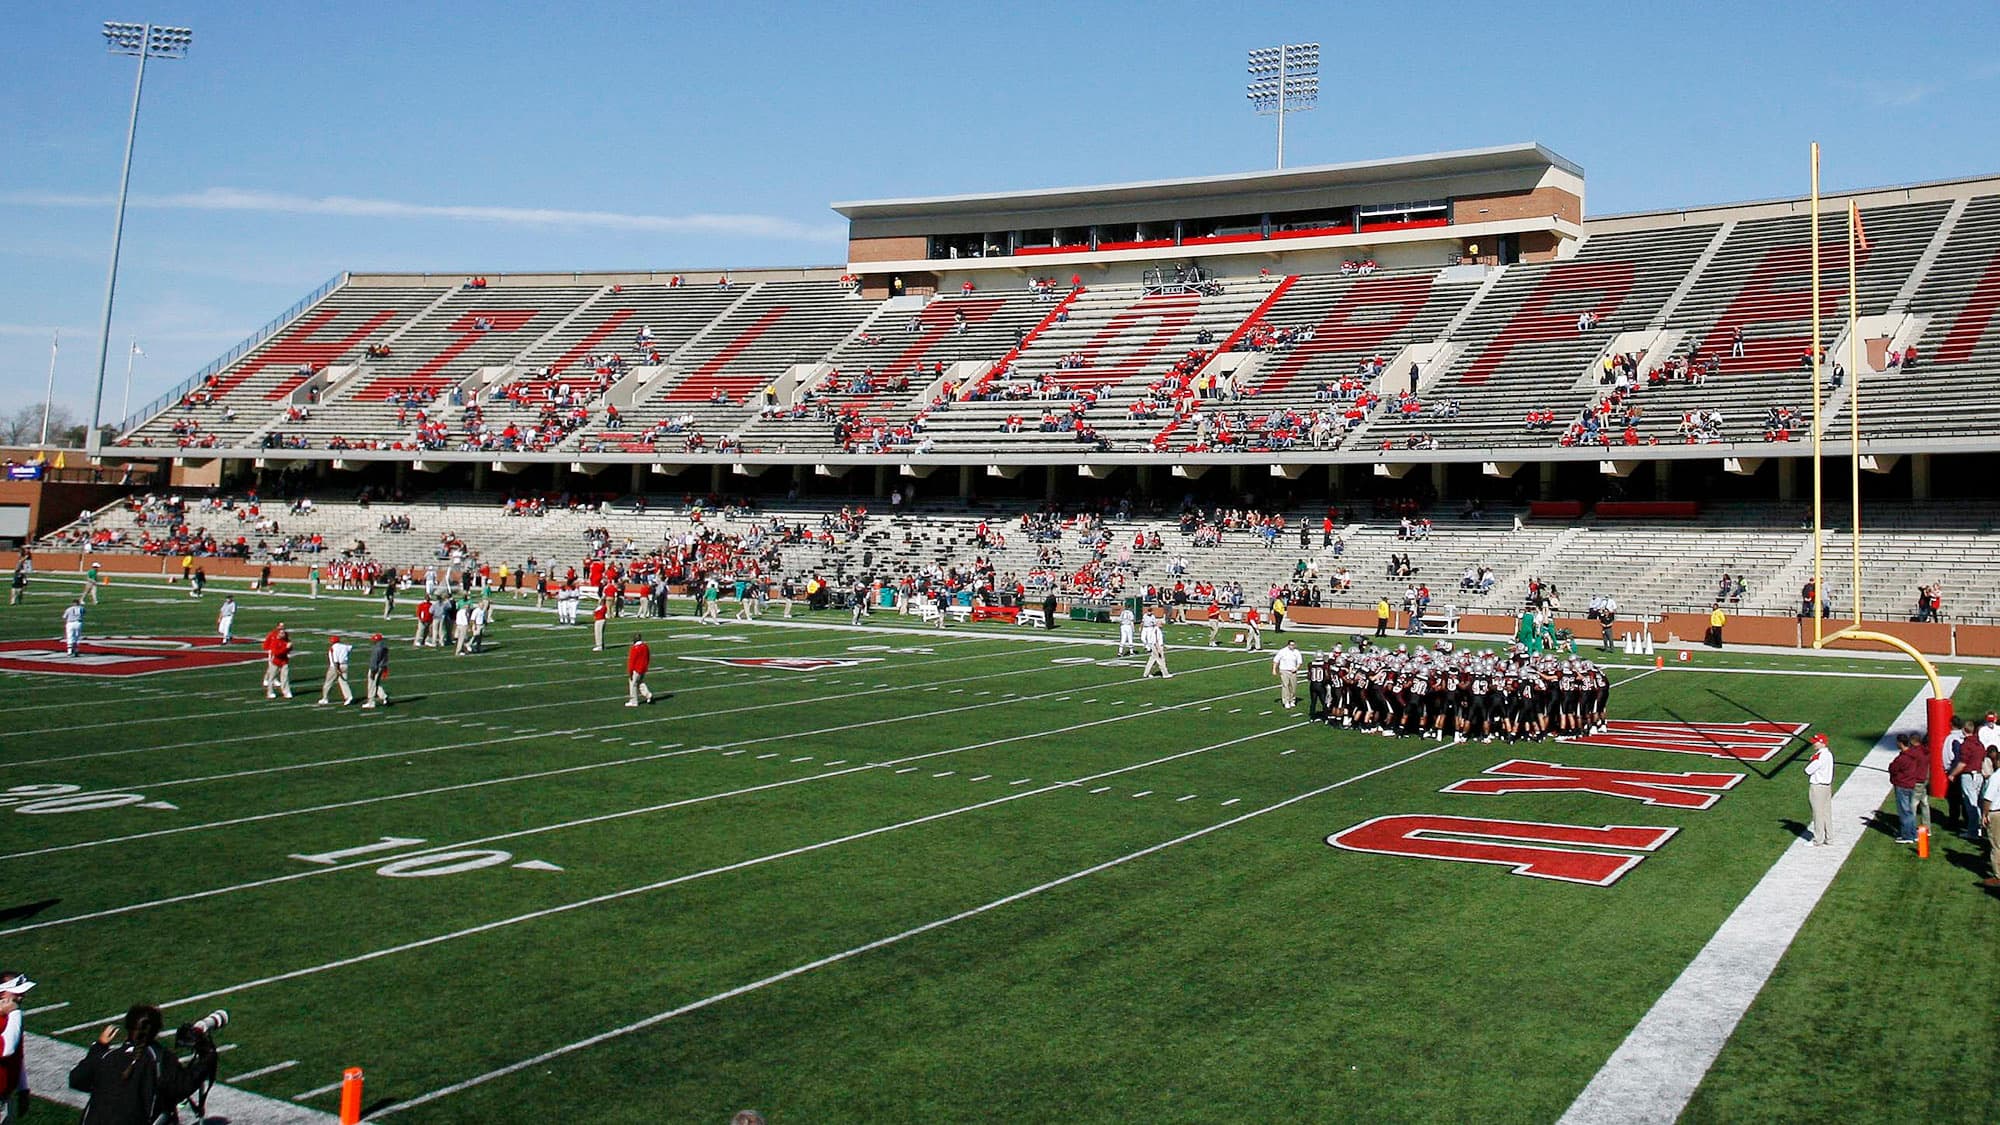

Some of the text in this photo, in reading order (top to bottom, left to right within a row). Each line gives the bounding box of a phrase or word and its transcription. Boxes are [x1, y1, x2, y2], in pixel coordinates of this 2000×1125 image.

[211, 241, 2000, 401] HILLTOPPE
[1311, 667, 1324, 682] 10
[1472, 679, 1489, 695] 43
[286, 836, 513, 878] 10
